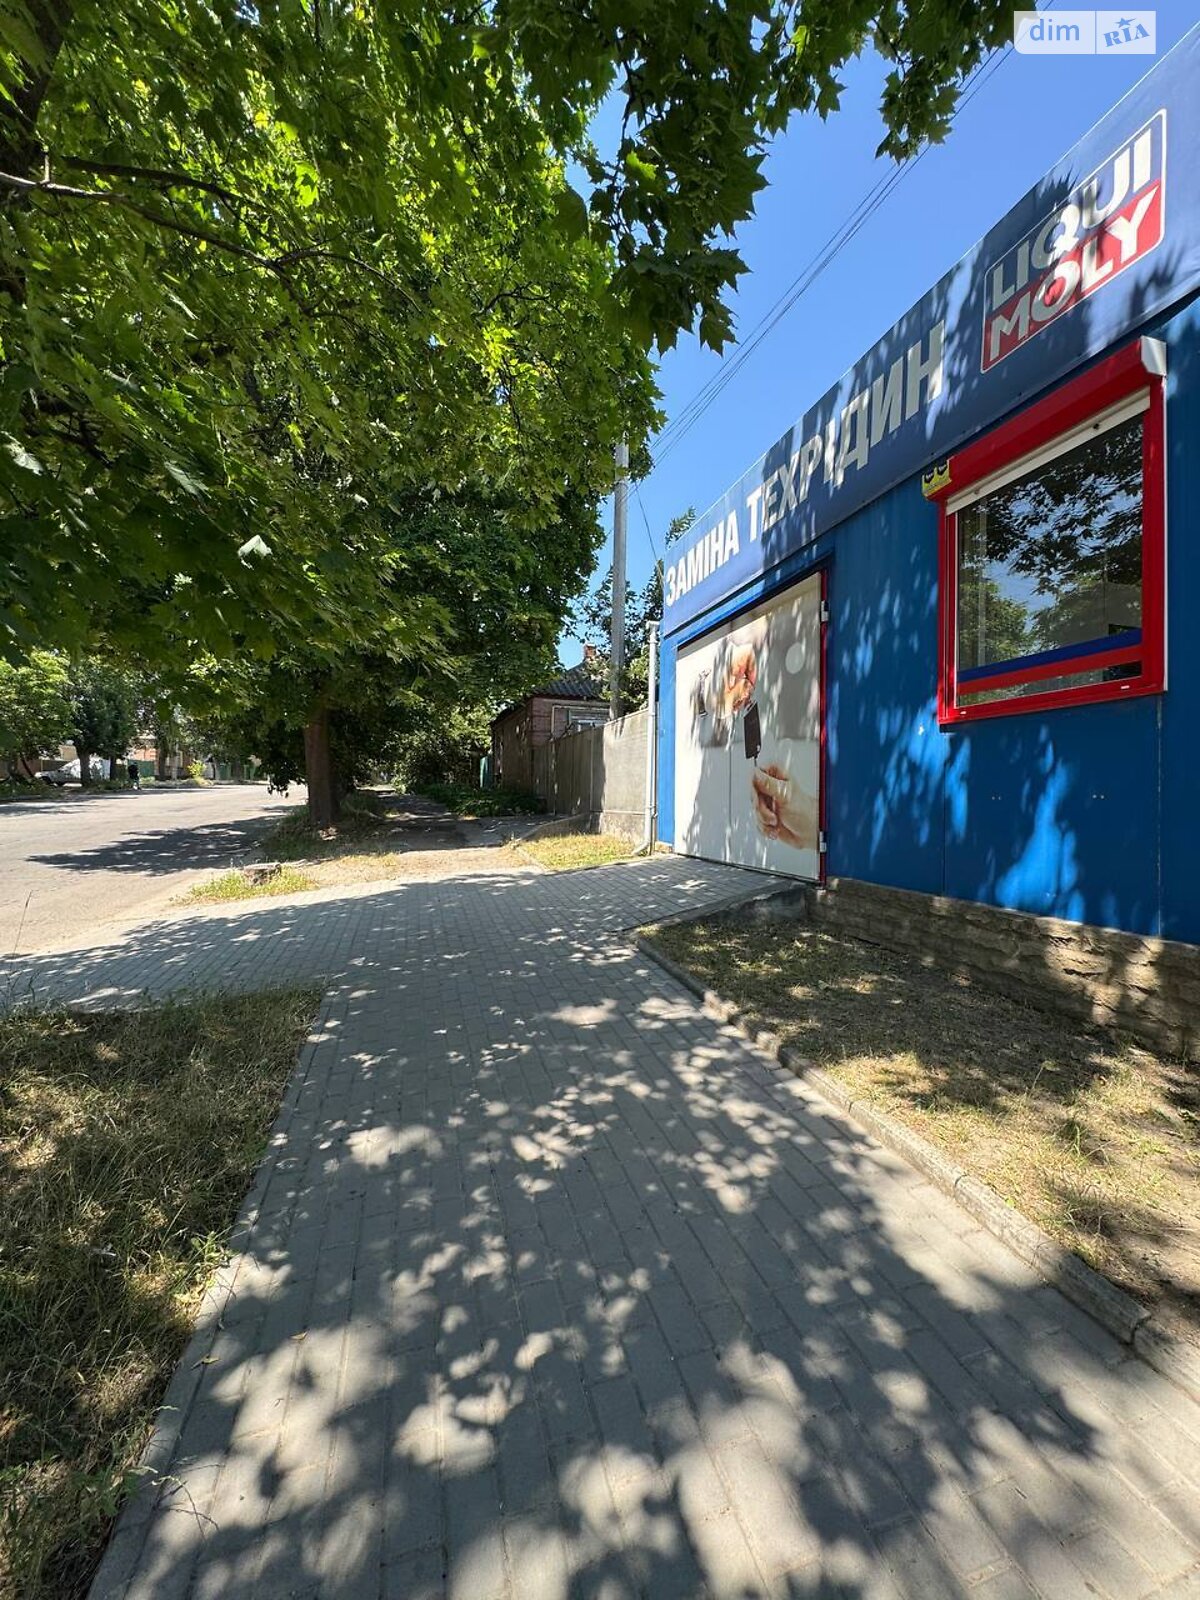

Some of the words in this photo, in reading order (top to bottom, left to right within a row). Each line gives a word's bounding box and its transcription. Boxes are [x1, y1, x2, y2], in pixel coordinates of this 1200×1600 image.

[989, 184, 1160, 362] MOLY
[992, 128, 1151, 310] LIQUI
[665, 509, 740, 607] ЗАМІНА
[746, 319, 945, 542] ТЕХРІДИН
